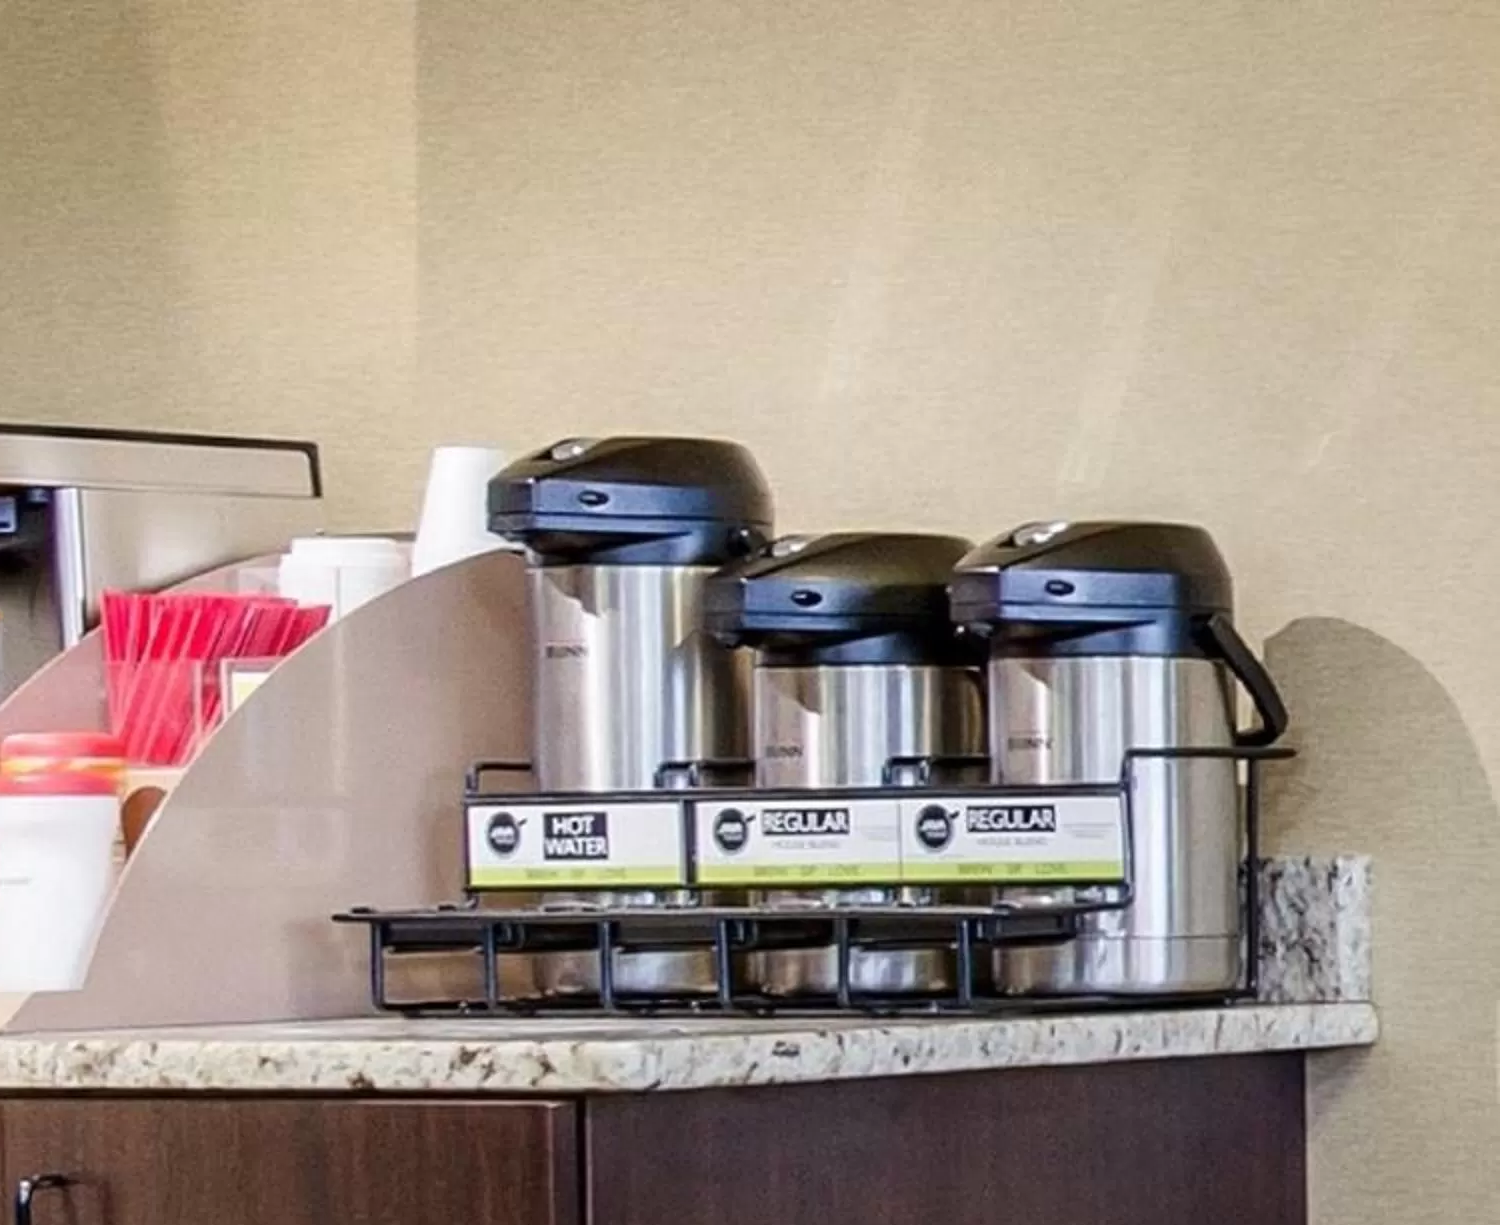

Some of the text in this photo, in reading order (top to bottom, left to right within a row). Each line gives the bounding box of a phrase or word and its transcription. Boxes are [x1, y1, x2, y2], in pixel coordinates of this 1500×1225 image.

[551, 815, 595, 835] HOT
[762, 811, 849, 833] REGULAR
[967, 808, 1055, 830] REGULAR
[544, 836, 608, 857] WATER
